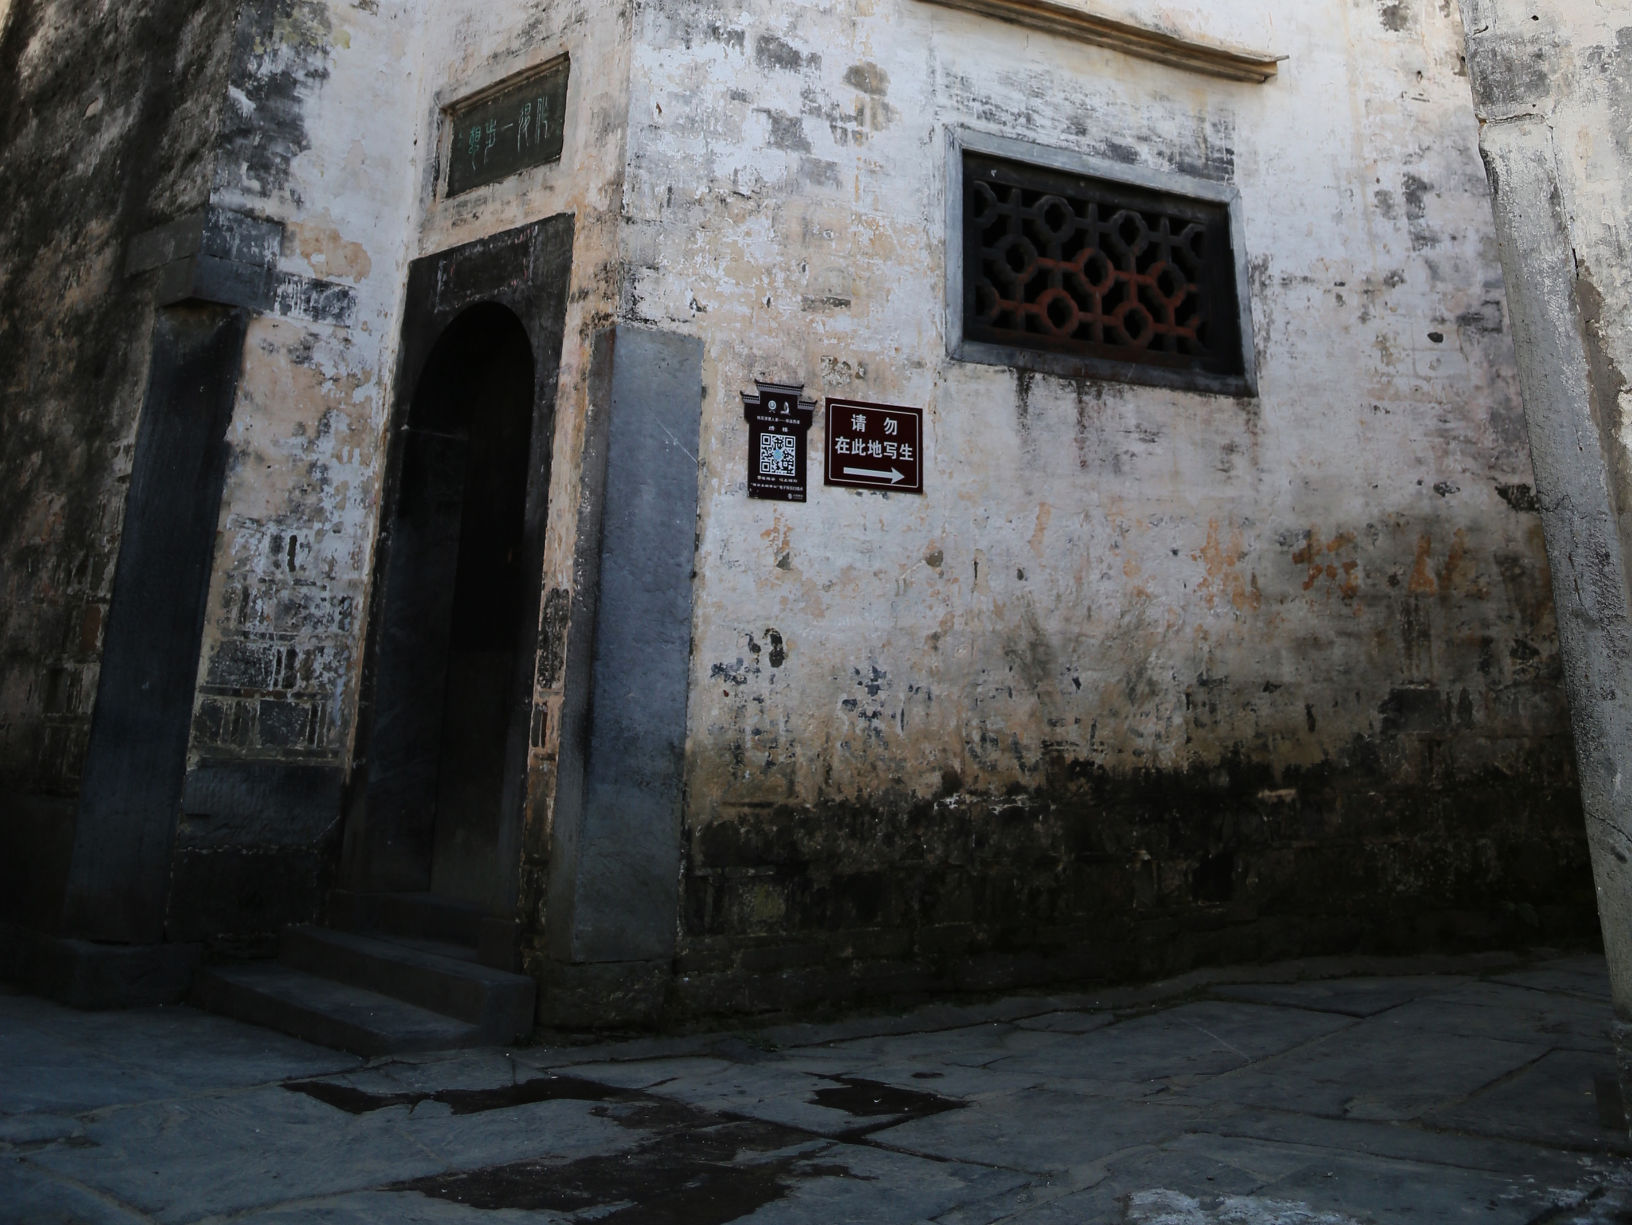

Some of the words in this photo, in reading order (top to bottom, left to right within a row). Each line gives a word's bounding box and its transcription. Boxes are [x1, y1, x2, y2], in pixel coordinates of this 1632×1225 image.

[851, 414, 898, 436] 请勿
[835, 436, 914, 461] 在此地写生
